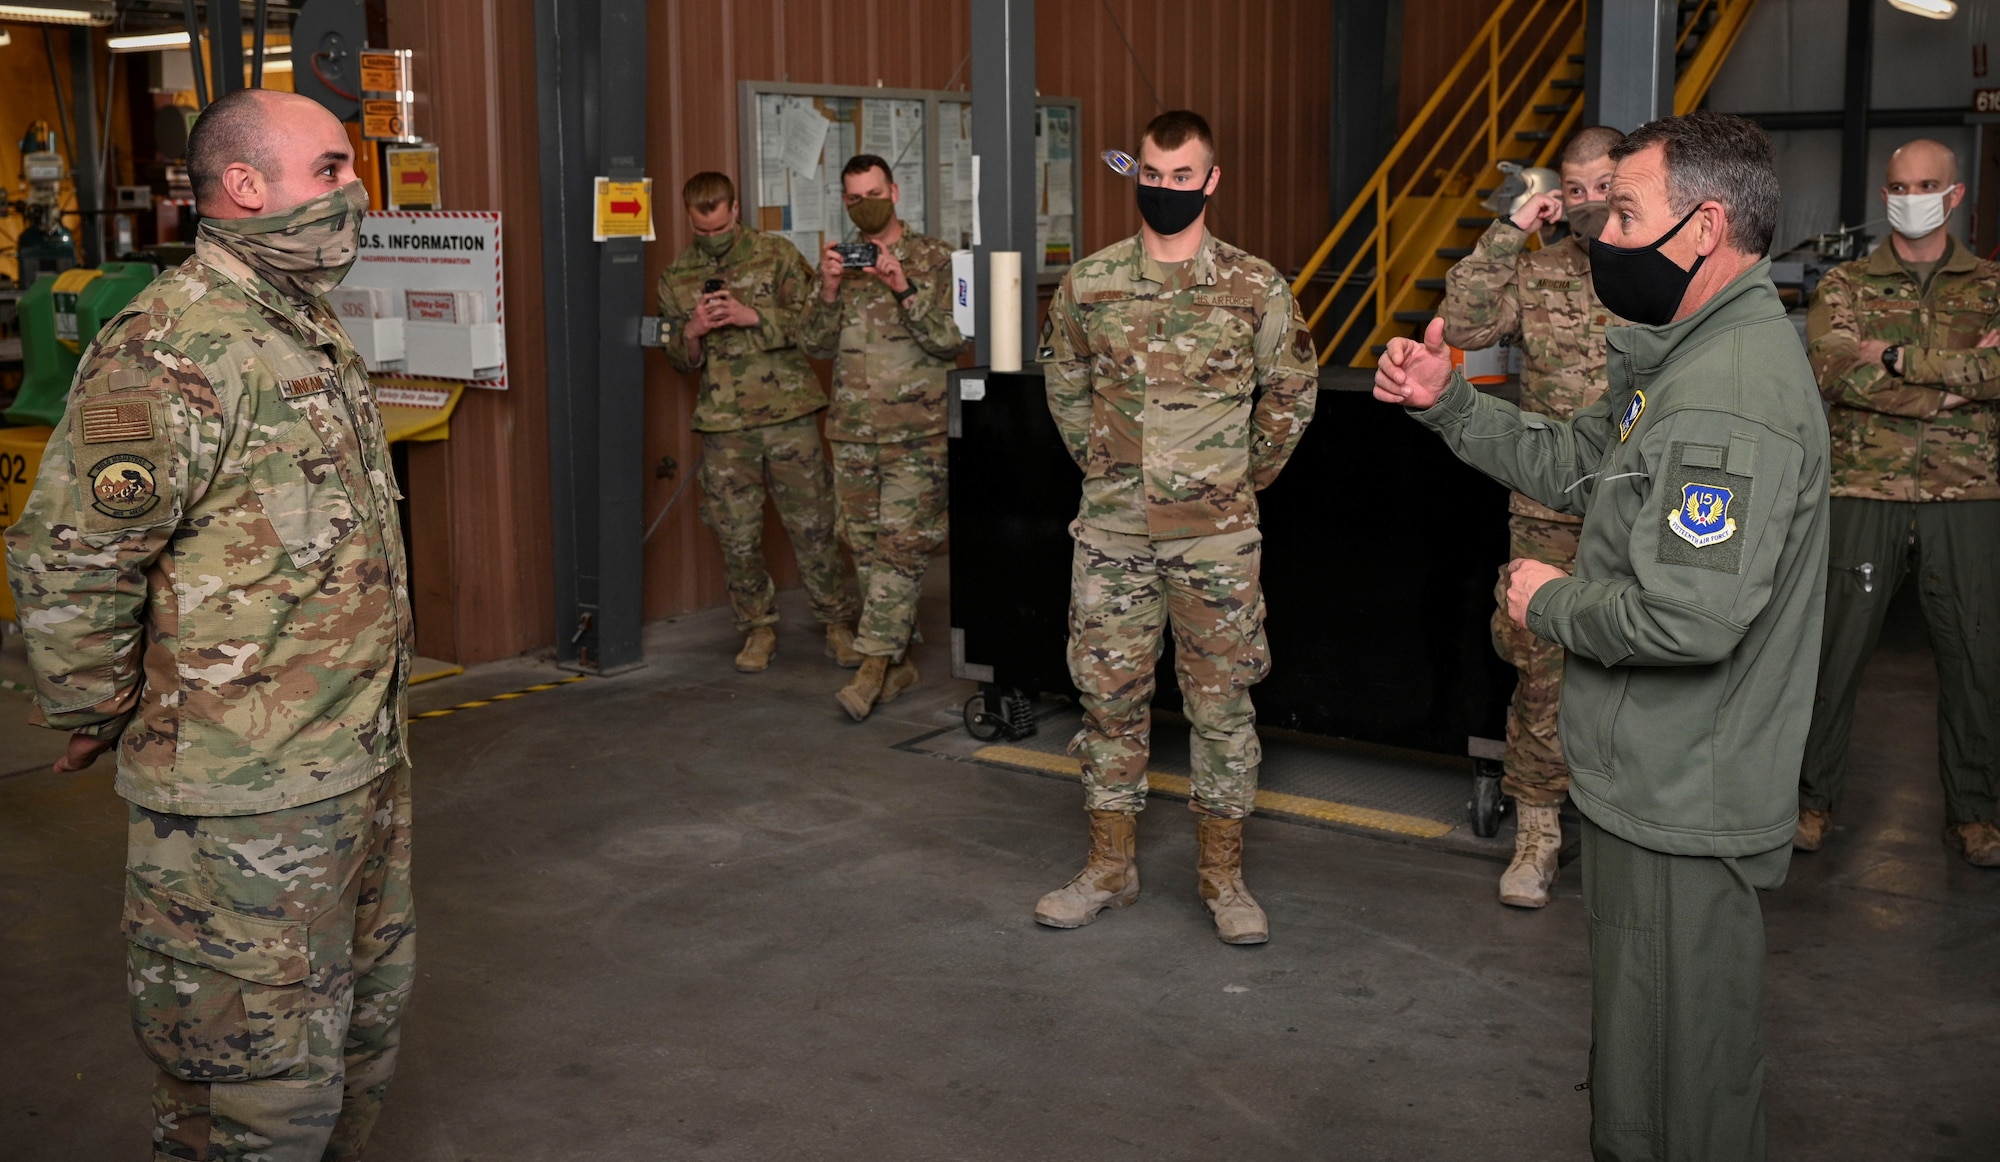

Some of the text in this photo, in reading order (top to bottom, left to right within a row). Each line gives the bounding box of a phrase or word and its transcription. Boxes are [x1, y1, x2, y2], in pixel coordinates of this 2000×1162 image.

[388, 234, 485, 251] INFORMATION
[397, 256, 429, 264] PRODUCTS
[430, 256, 471, 265] INFORMATION
[411, 300, 450, 310] Safety Data
[1212, 295, 1224, 305] AIR
[1225, 295, 1248, 306] FORCE
[341, 303, 365, 318] SDS
[420, 310, 444, 319] Sheets
[1699, 492, 1713, 505] 15
[1672, 521, 1730, 545] FIFTEENTH AIR FORCE
